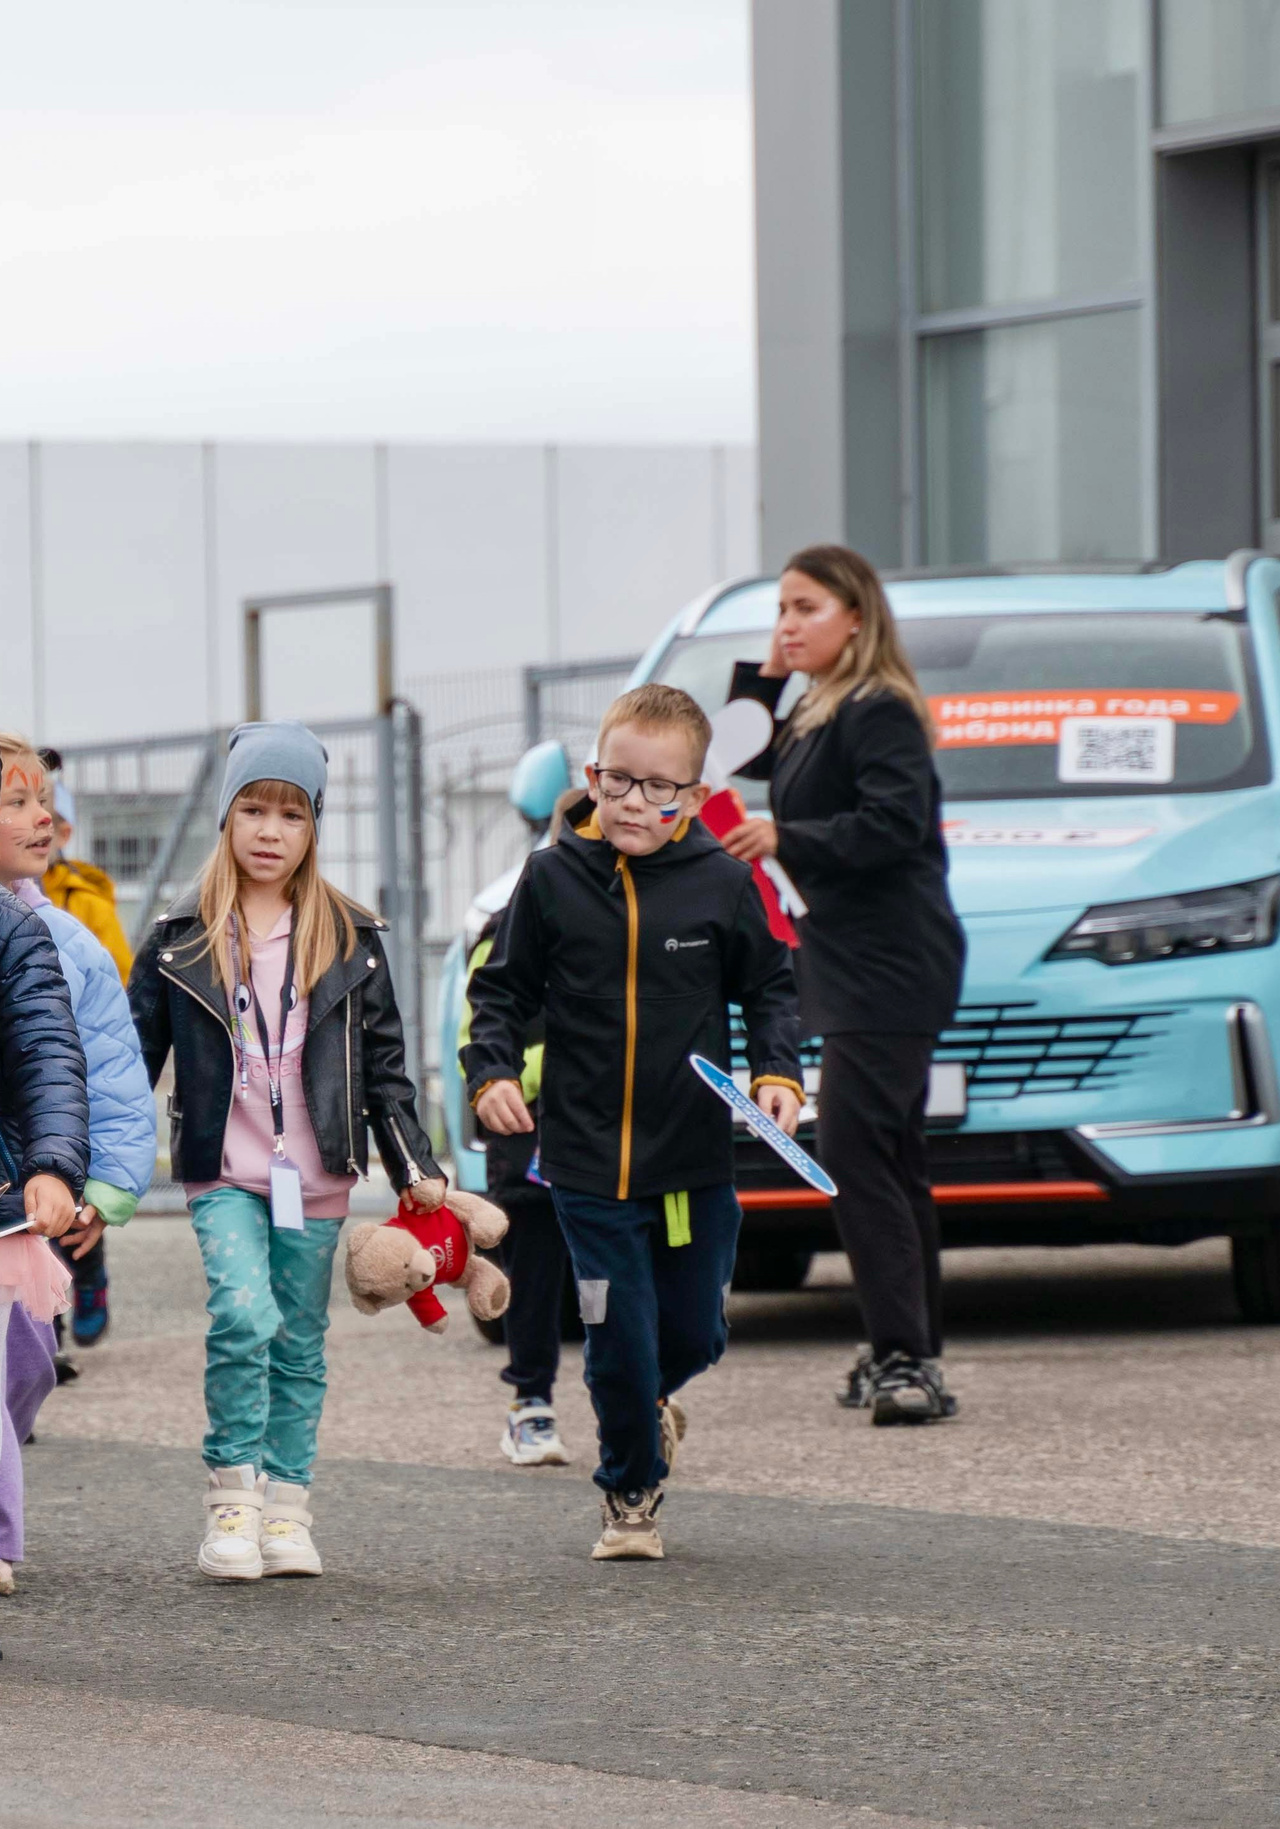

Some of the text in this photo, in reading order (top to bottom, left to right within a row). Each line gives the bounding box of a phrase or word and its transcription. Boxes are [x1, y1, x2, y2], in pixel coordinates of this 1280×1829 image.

[940, 698, 1096, 720] Новинка
[1106, 698, 1190, 717] года
[941, 718, 1056, 742] ибрид
[444, 1236, 454, 1272] TOYOTA
